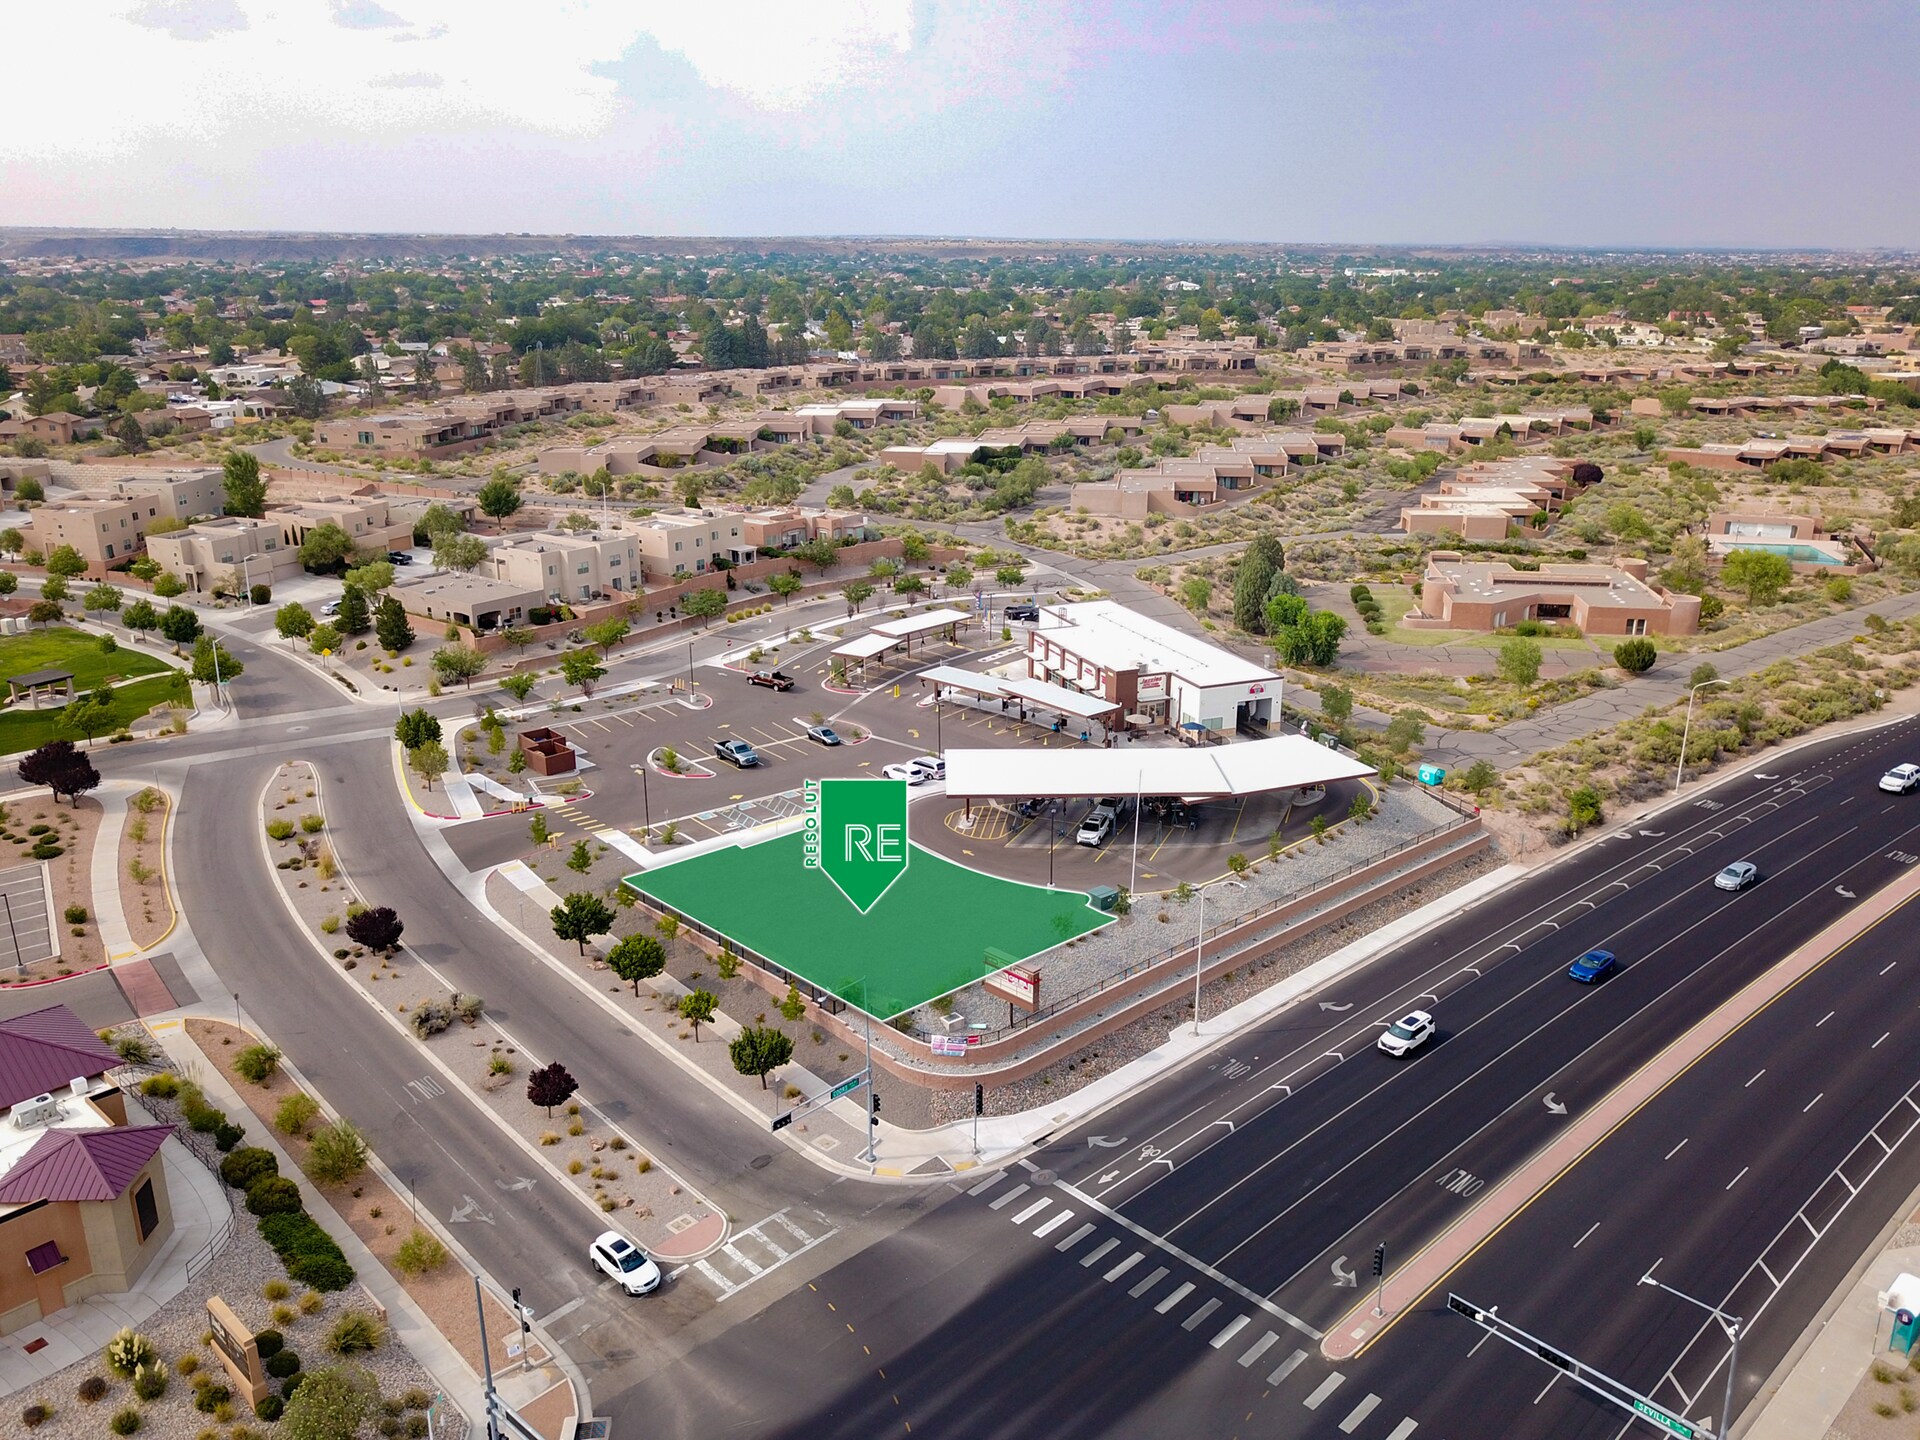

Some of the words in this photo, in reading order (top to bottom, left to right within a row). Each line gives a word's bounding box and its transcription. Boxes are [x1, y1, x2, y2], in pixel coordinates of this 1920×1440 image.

[1693, 799, 1725, 811] ONLY
[1884, 850, 1919, 865] ONLY
[402, 1075, 446, 1105] ONLY
[1435, 1167, 1485, 1198] ONLY
[1638, 1403, 1671, 1427] SEVILLA
